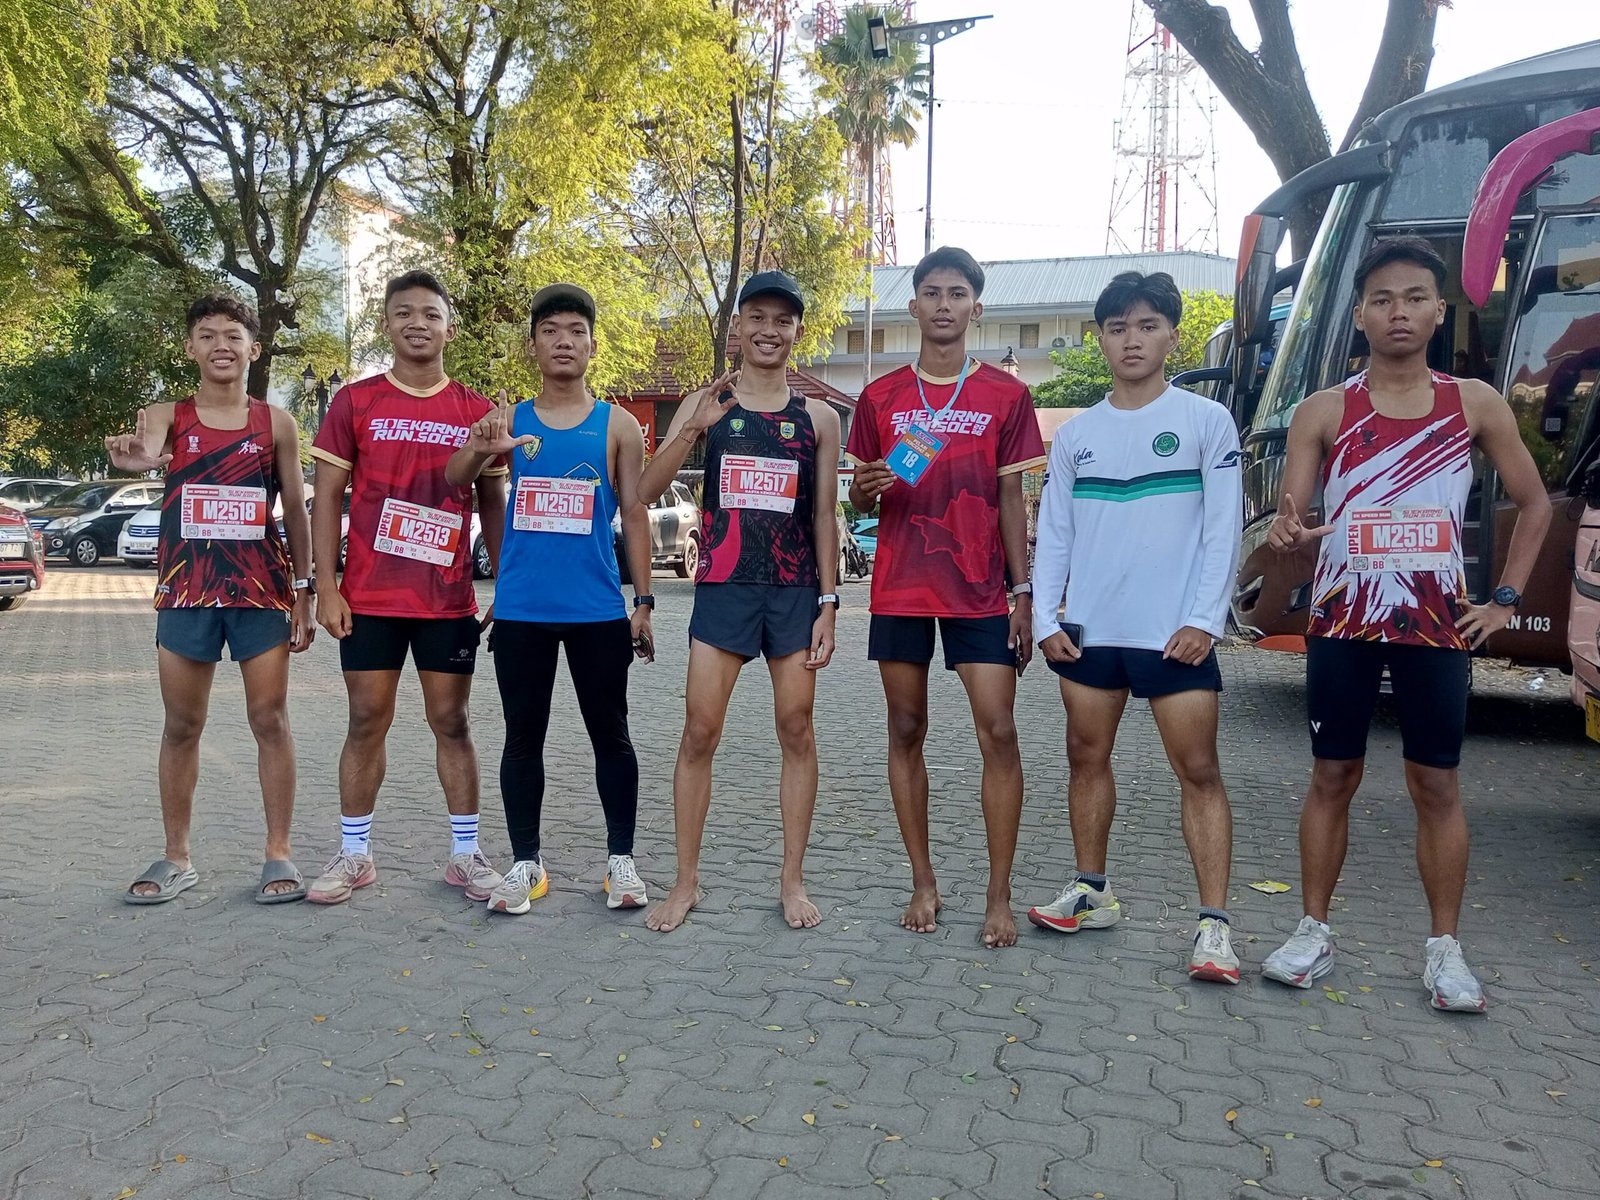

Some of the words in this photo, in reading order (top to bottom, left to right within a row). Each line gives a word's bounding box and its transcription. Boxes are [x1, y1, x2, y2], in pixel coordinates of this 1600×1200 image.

[368, 418, 470, 437] SOEKARNO
[373, 429, 453, 445] RUN.SOC
[901, 450, 919, 468] 18
[721, 468, 730, 493] OPEN
[740, 470, 788, 492] M2517
[183, 498, 192, 523] OPEN
[202, 500, 256, 521] M2518
[516, 490, 526, 515] OPEN
[534, 492, 584, 514] M2516
[379, 511, 392, 537] OPEN
[398, 517, 451, 546] M2513
[1372, 523, 1438, 548] M2519
[1348, 524, 1359, 554] OPEN
[1525, 616, 1551, 632] 103
